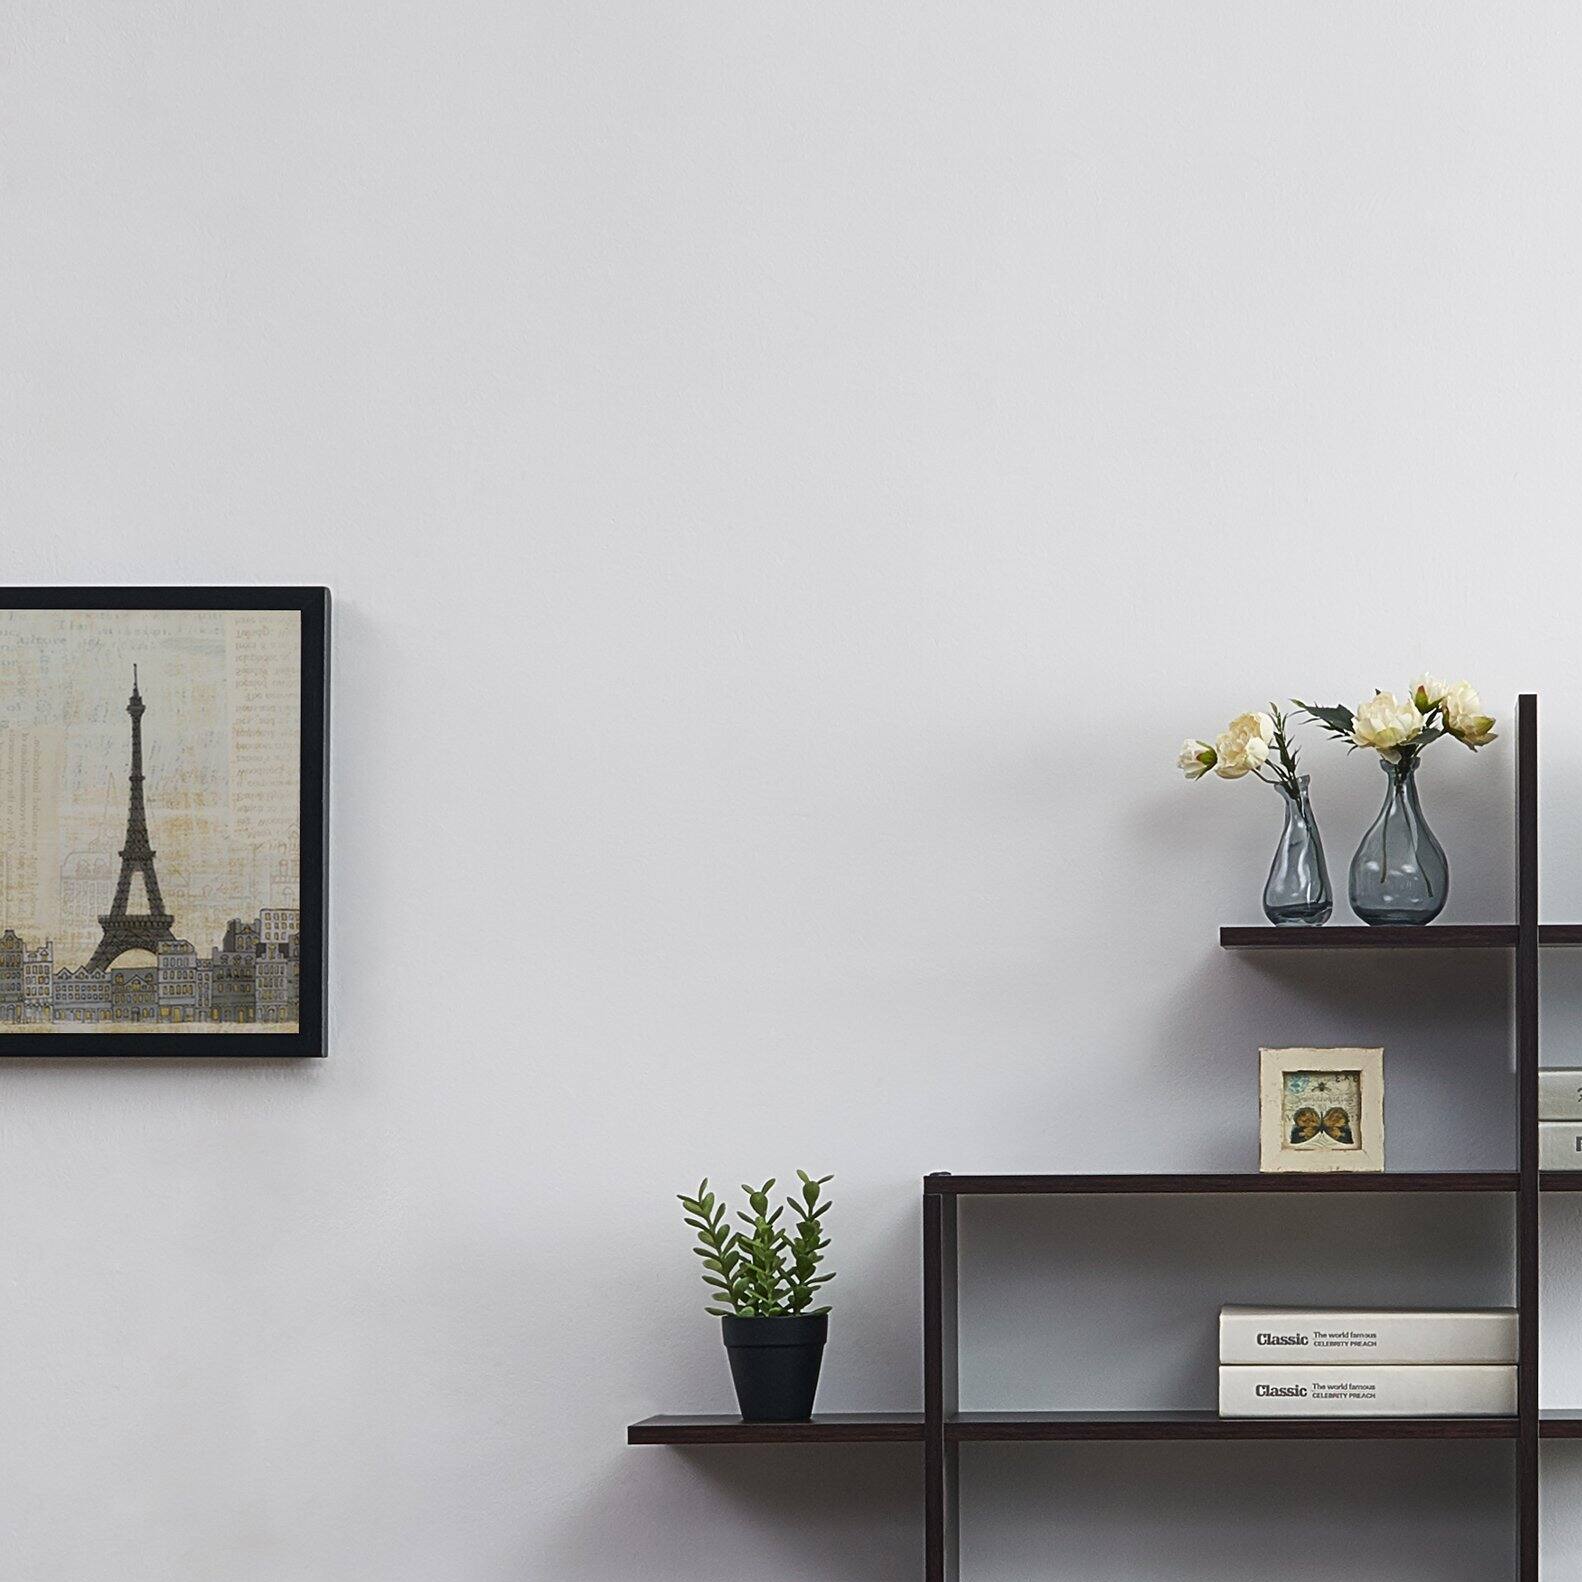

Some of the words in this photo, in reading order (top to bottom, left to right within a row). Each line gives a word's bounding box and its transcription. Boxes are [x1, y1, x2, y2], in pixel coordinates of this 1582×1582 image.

[1256, 1333, 1309, 1346] Classic
[1314, 1331, 1327, 1339] The
[1328, 1331, 1349, 1339] world
[1350, 1331, 1377, 1339] famous
[1255, 1384, 1308, 1397] Classic
